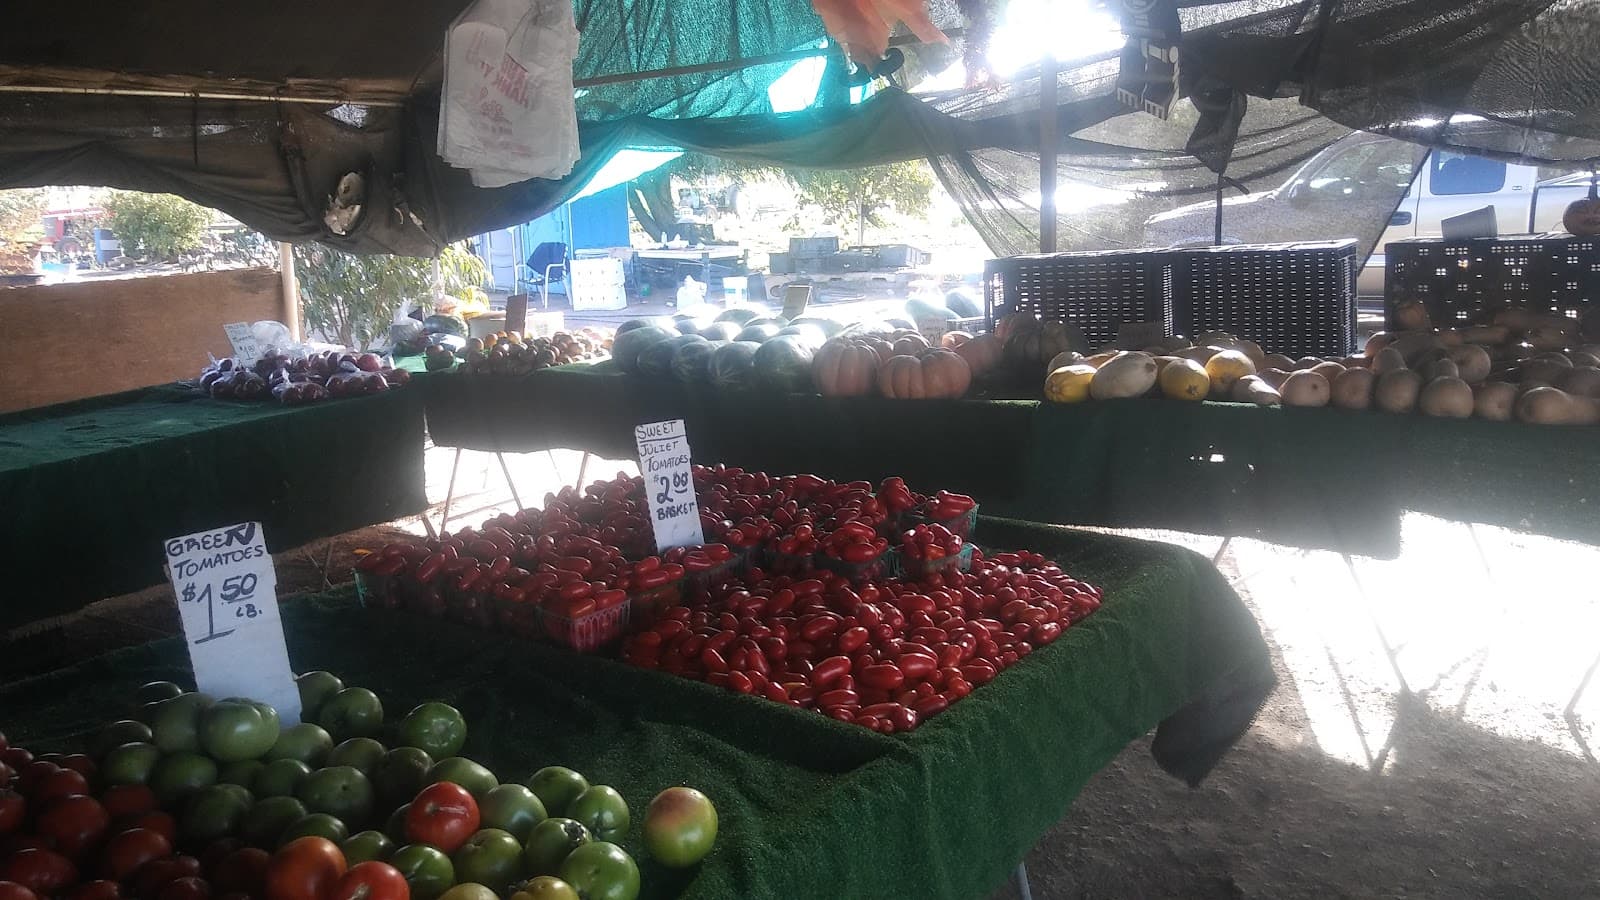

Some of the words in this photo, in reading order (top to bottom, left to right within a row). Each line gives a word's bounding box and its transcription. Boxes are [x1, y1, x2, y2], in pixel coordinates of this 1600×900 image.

[637, 421, 677, 440] SWEET
[640, 440, 679, 457] JULIET
[645, 455, 689, 472] TOMATOES
[656, 502, 695, 520] BASKET
[167, 522, 256, 556] GREEN
[174, 545, 264, 579] TOMATOES
